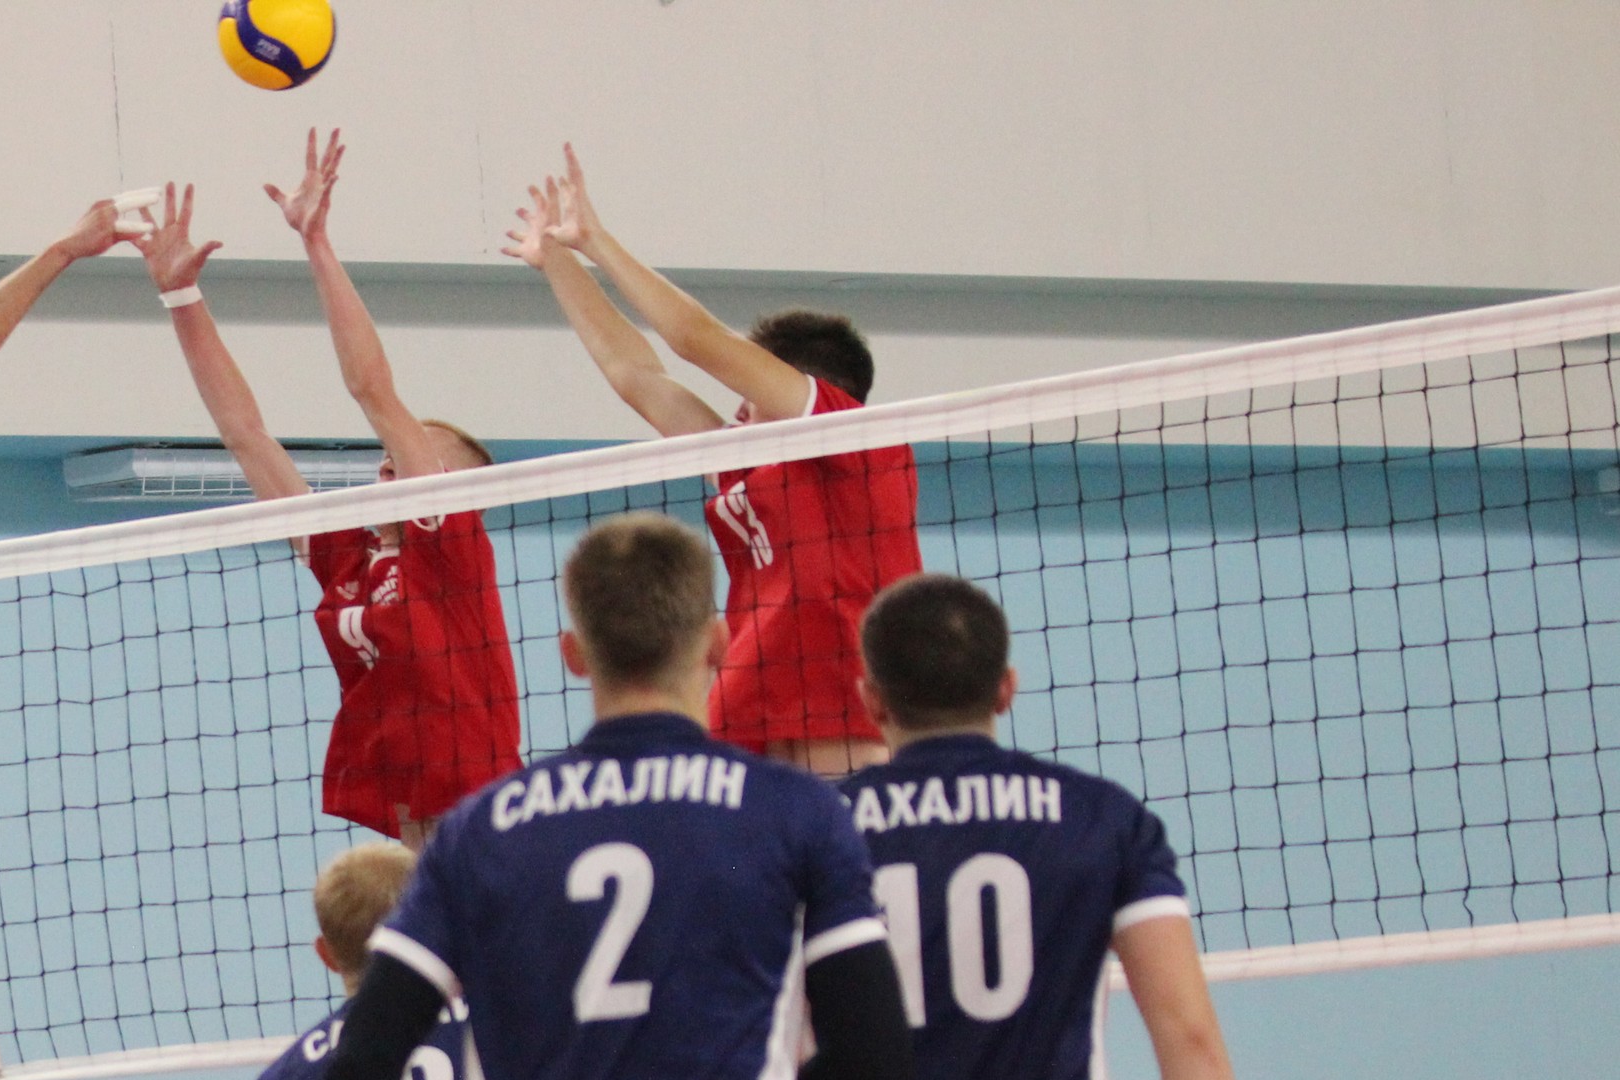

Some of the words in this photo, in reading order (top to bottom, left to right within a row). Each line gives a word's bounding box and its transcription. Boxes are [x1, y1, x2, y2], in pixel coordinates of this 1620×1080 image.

[490, 753, 747, 832] САХАЛИН
[843, 773, 1062, 834] АХАЛИН
[565, 841, 654, 1024] 2
[870, 851, 1034, 1028] 10
